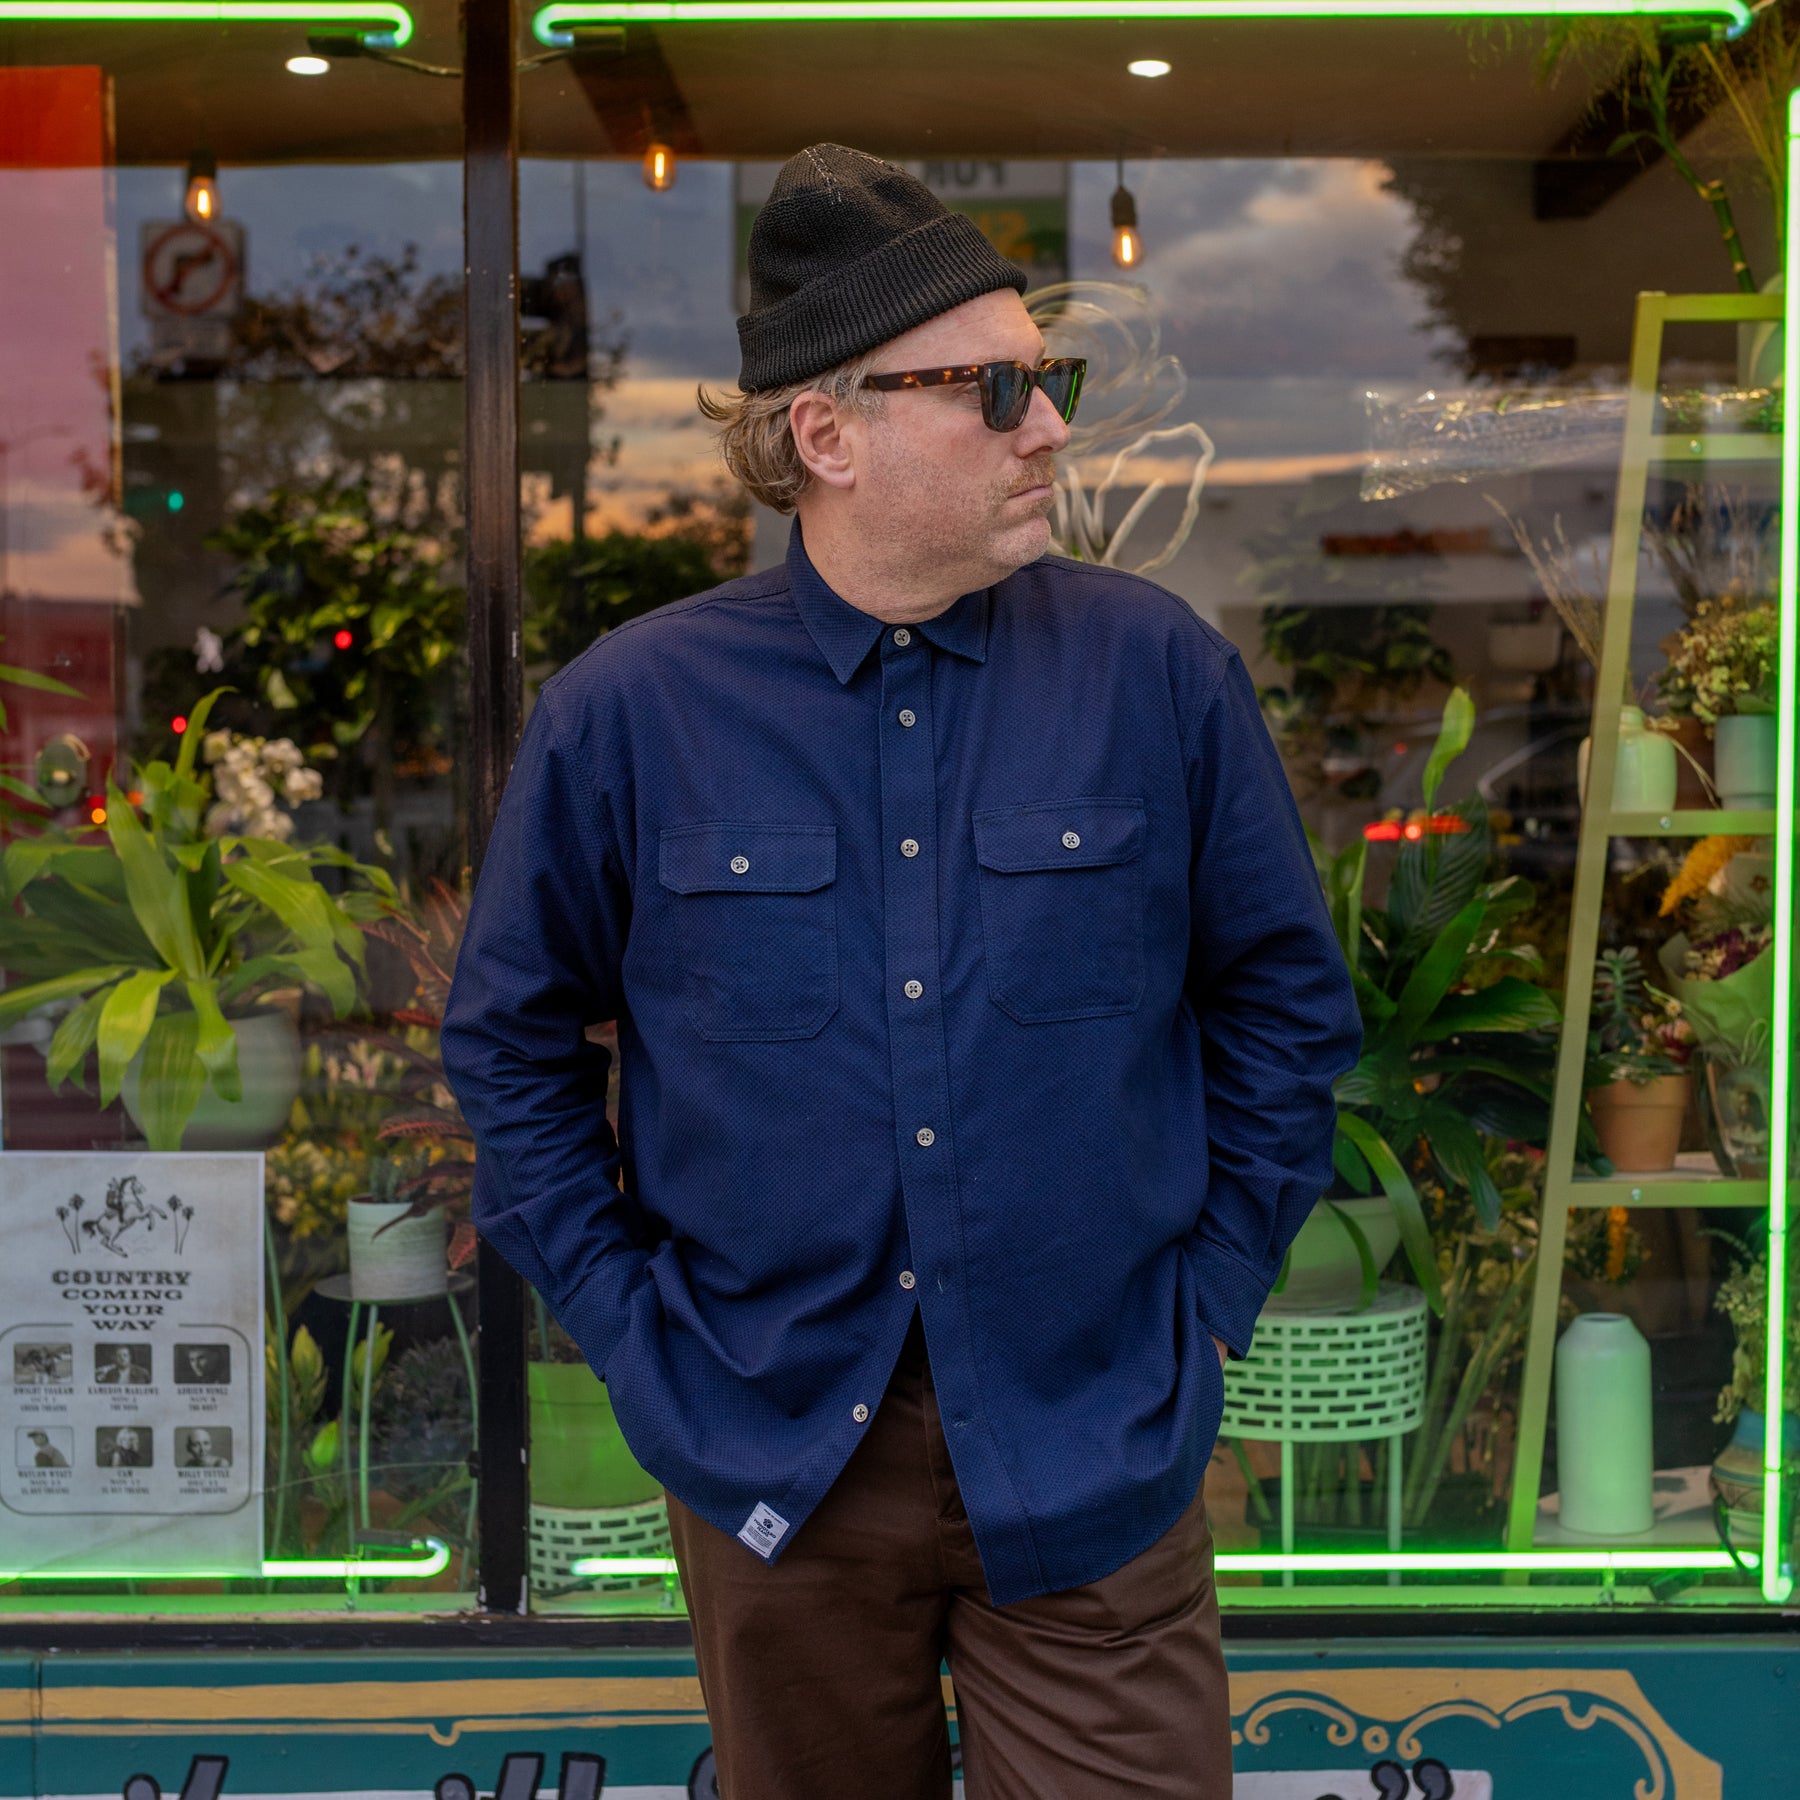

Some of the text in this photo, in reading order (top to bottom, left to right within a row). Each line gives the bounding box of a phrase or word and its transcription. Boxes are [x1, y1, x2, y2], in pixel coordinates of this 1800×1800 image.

[52, 1269, 191, 1286] COUNTRY
[62, 1288, 183, 1300] COMING
[82, 1303, 164, 1316] YOUR
[92, 1319, 156, 1331] WAY
